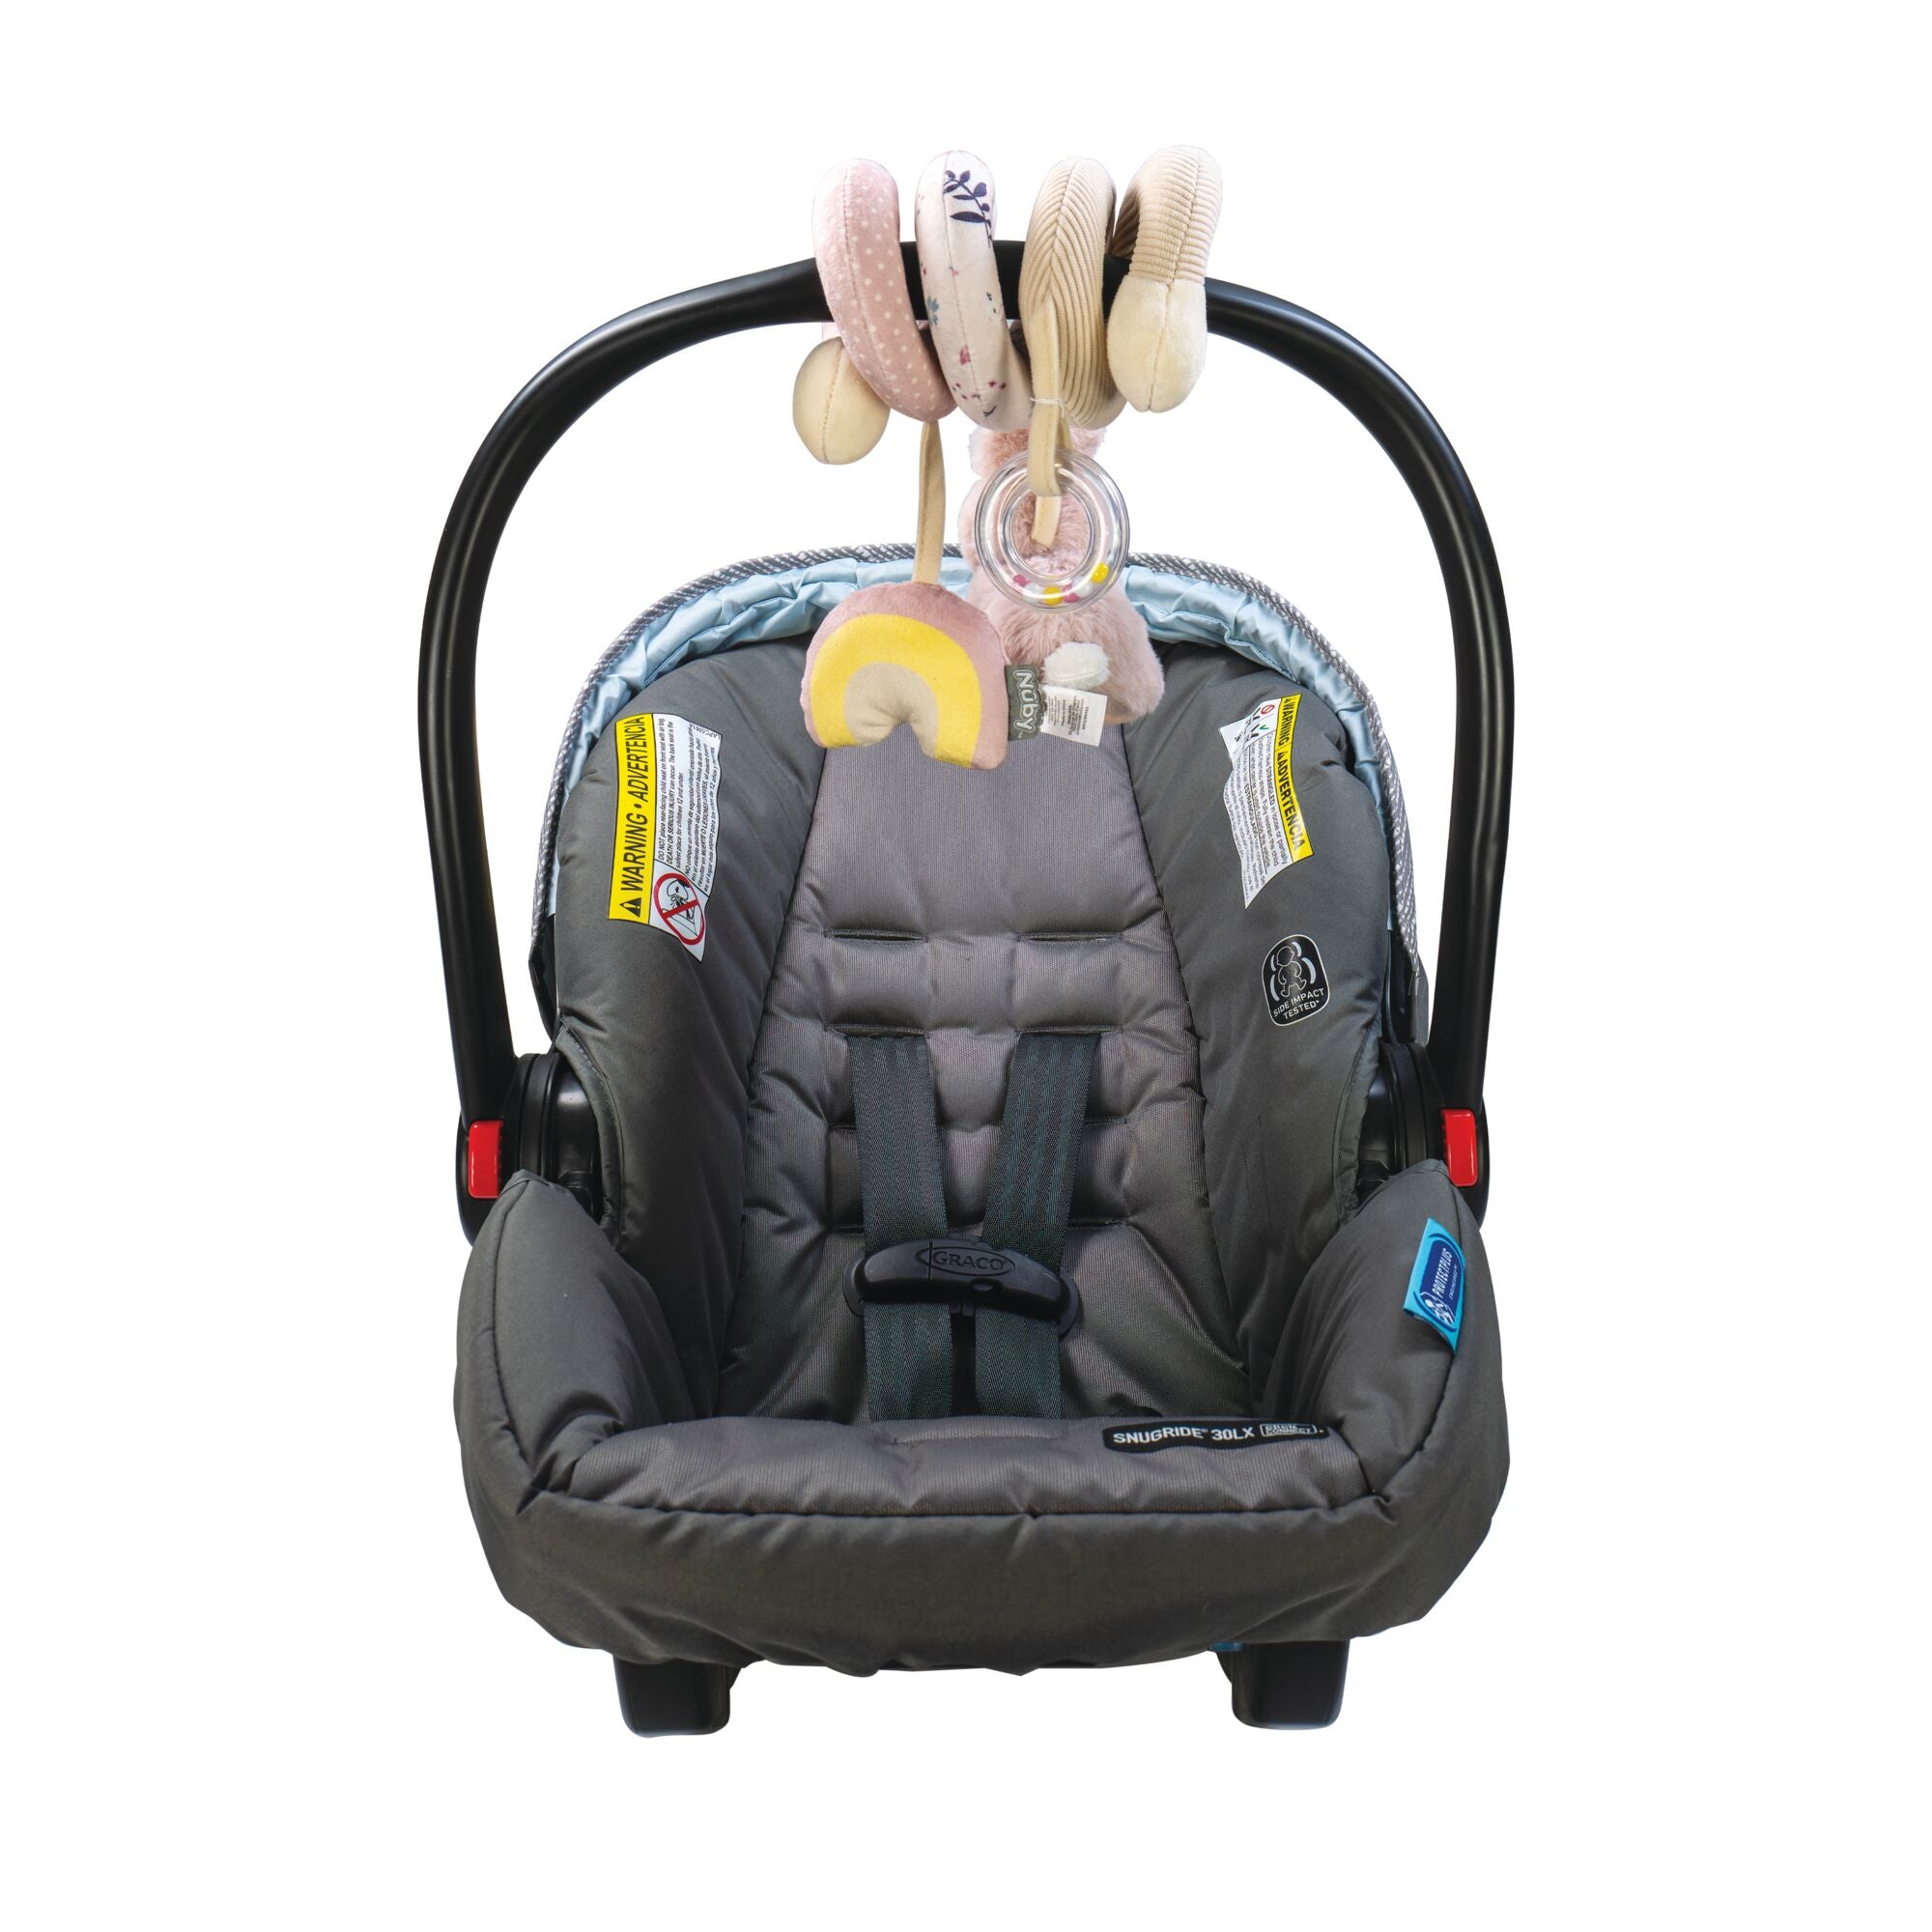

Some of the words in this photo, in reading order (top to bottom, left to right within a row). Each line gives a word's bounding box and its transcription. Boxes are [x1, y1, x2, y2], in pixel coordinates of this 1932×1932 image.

[1278, 701, 1295, 747] WARNING
[623, 717, 648, 802] ADVERTENCIA
[1244, 783, 1258, 838] ESTRANGULADO
[1266, 766, 1275, 805] STRANGLED
[1277, 839, 1289, 865] partially
[1277, 758, 1305, 851] ADVERTENCIA
[620, 813, 647, 891] WARNING
[658, 851, 664, 860] DO
[668, 835, 673, 843] OR
[685, 866, 691, 875] NO
[1273, 1001, 1291, 1017] SIDE
[1291, 988, 1324, 1005] IMPACT
[932, 1251, 1005, 1271] GRACO
[1210, 1427, 1255, 1441] 30LX
